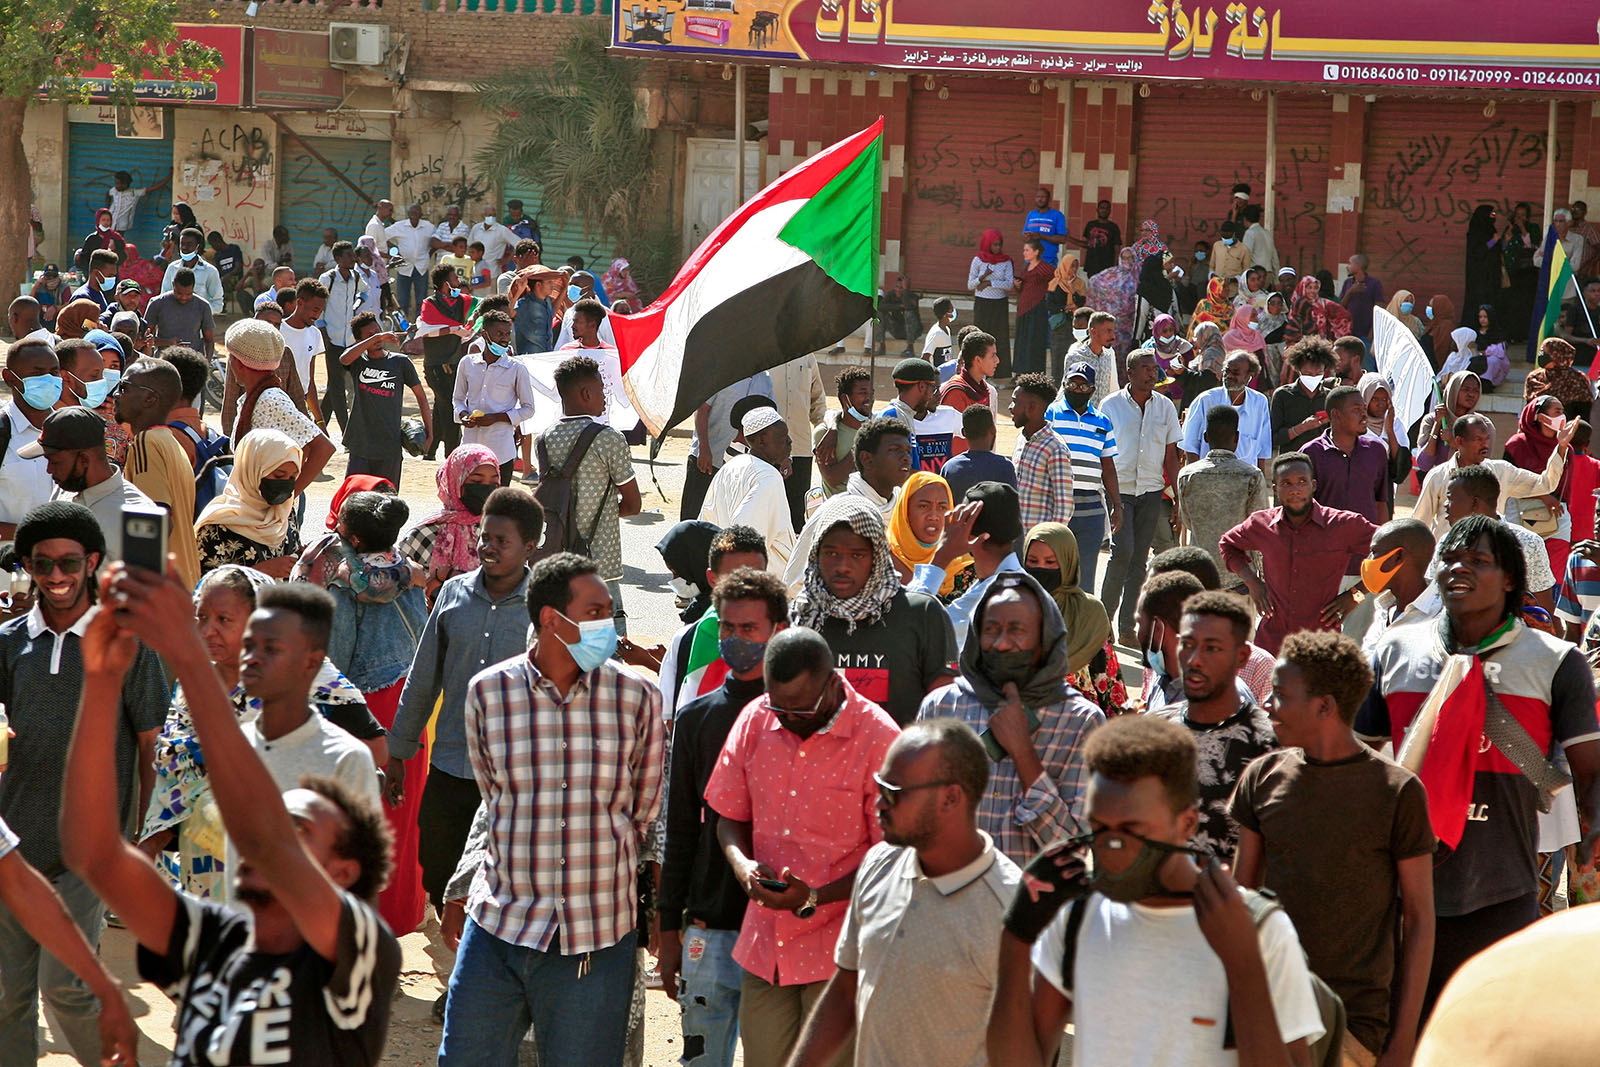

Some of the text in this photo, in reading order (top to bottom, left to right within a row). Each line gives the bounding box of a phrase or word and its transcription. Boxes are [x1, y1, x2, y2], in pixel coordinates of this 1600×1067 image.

[903, 49, 929, 64] ترابيز
[937, 51, 955, 64] صفر
[963, 52, 987, 65] فاخرة
[987, 54, 1010, 67] جلوس
[1011, 54, 1032, 67] أطقم
[1040, 56, 1055, 69] نوم
[1055, 56, 1074, 70] غرف
[1083, 59, 1107, 71] سراير
[1115, 60, 1143, 72] دواليب
[1341, 66, 1419, 80] 0116840610
[1430, 69, 1512, 83] 0911470999
[201, 123, 266, 153] ACAB
[381, 381, 395, 390] AIR
[917, 445, 948, 454] RBAN
[837, 653, 886, 669] MMY
[1414, 656, 1503, 685] SUR
